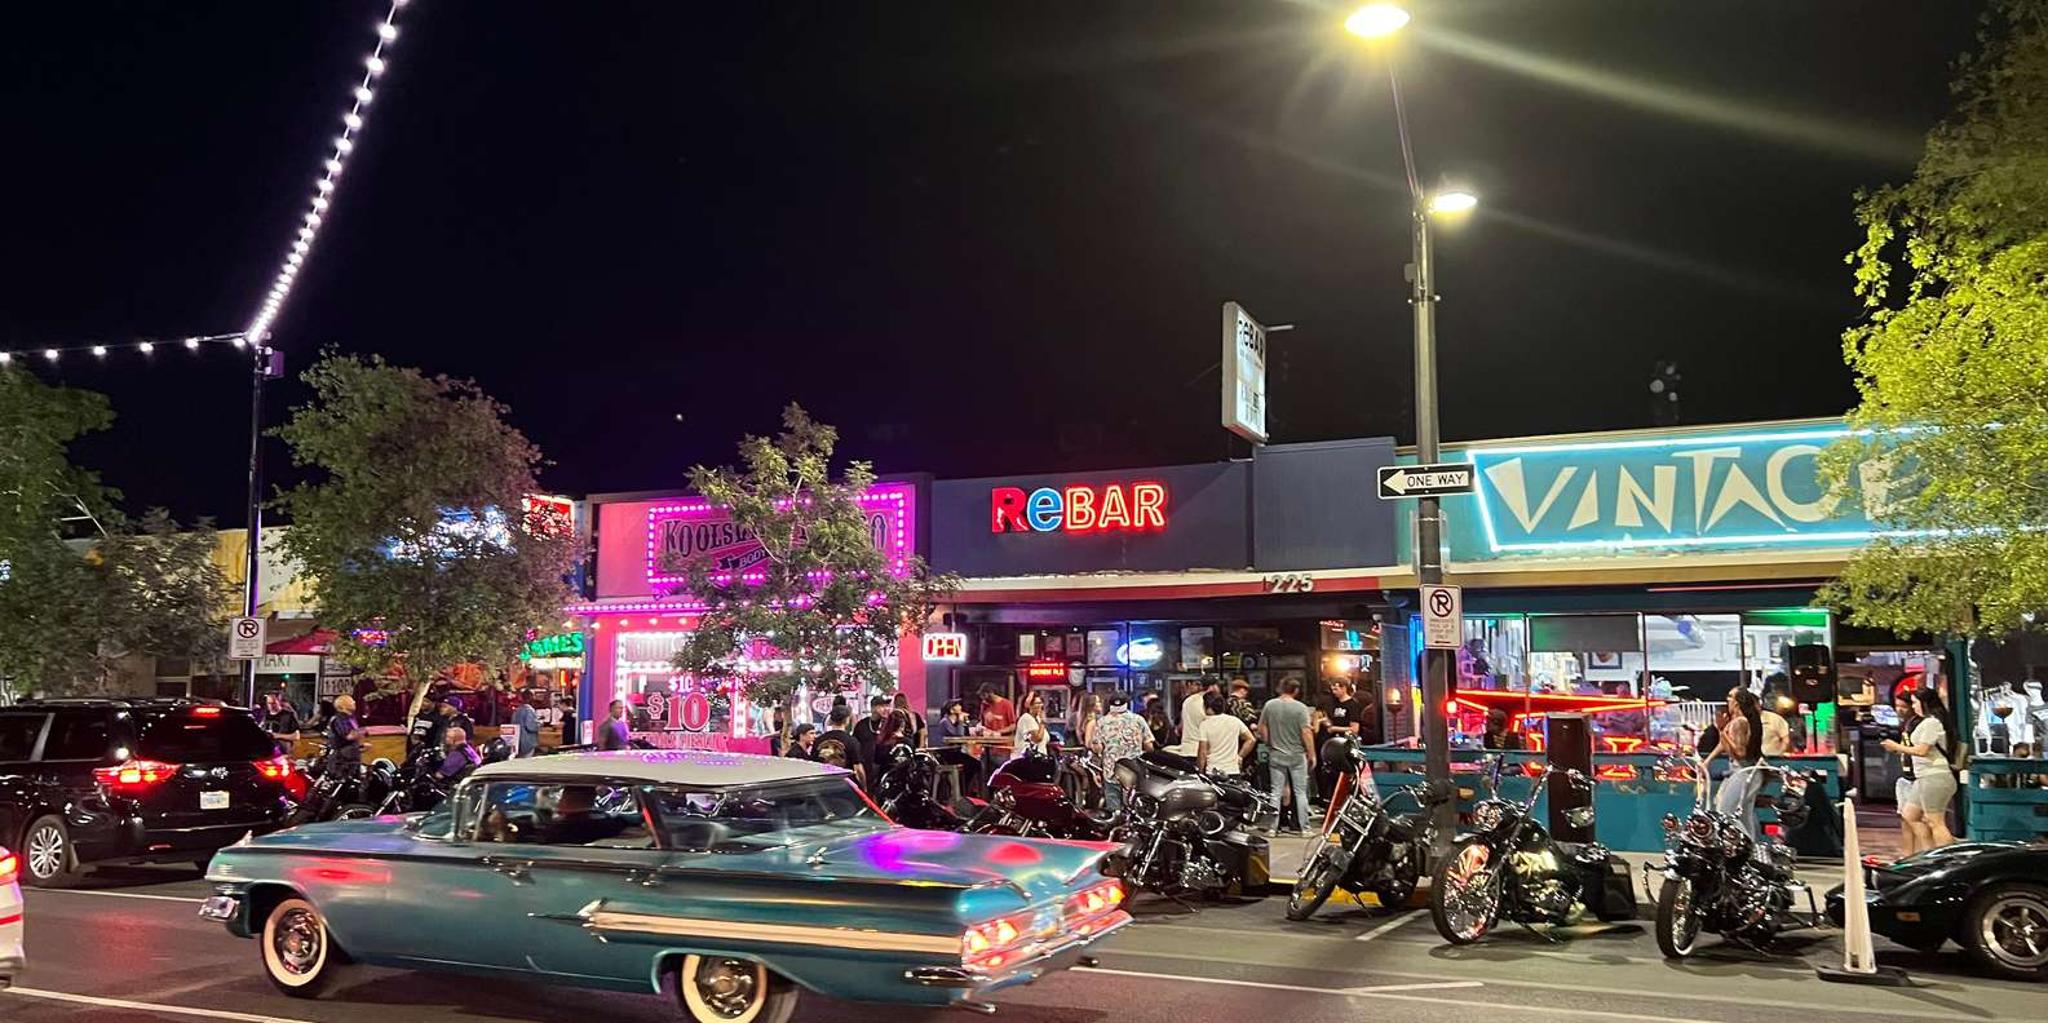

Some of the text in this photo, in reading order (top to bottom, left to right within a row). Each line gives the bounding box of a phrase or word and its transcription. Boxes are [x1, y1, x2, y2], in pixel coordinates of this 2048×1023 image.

[1406, 472, 1465, 487] ONE WAY
[991, 484, 1166, 533] ReBAR
[925, 636, 964, 658] OPEN
[646, 691, 711, 731] $10
